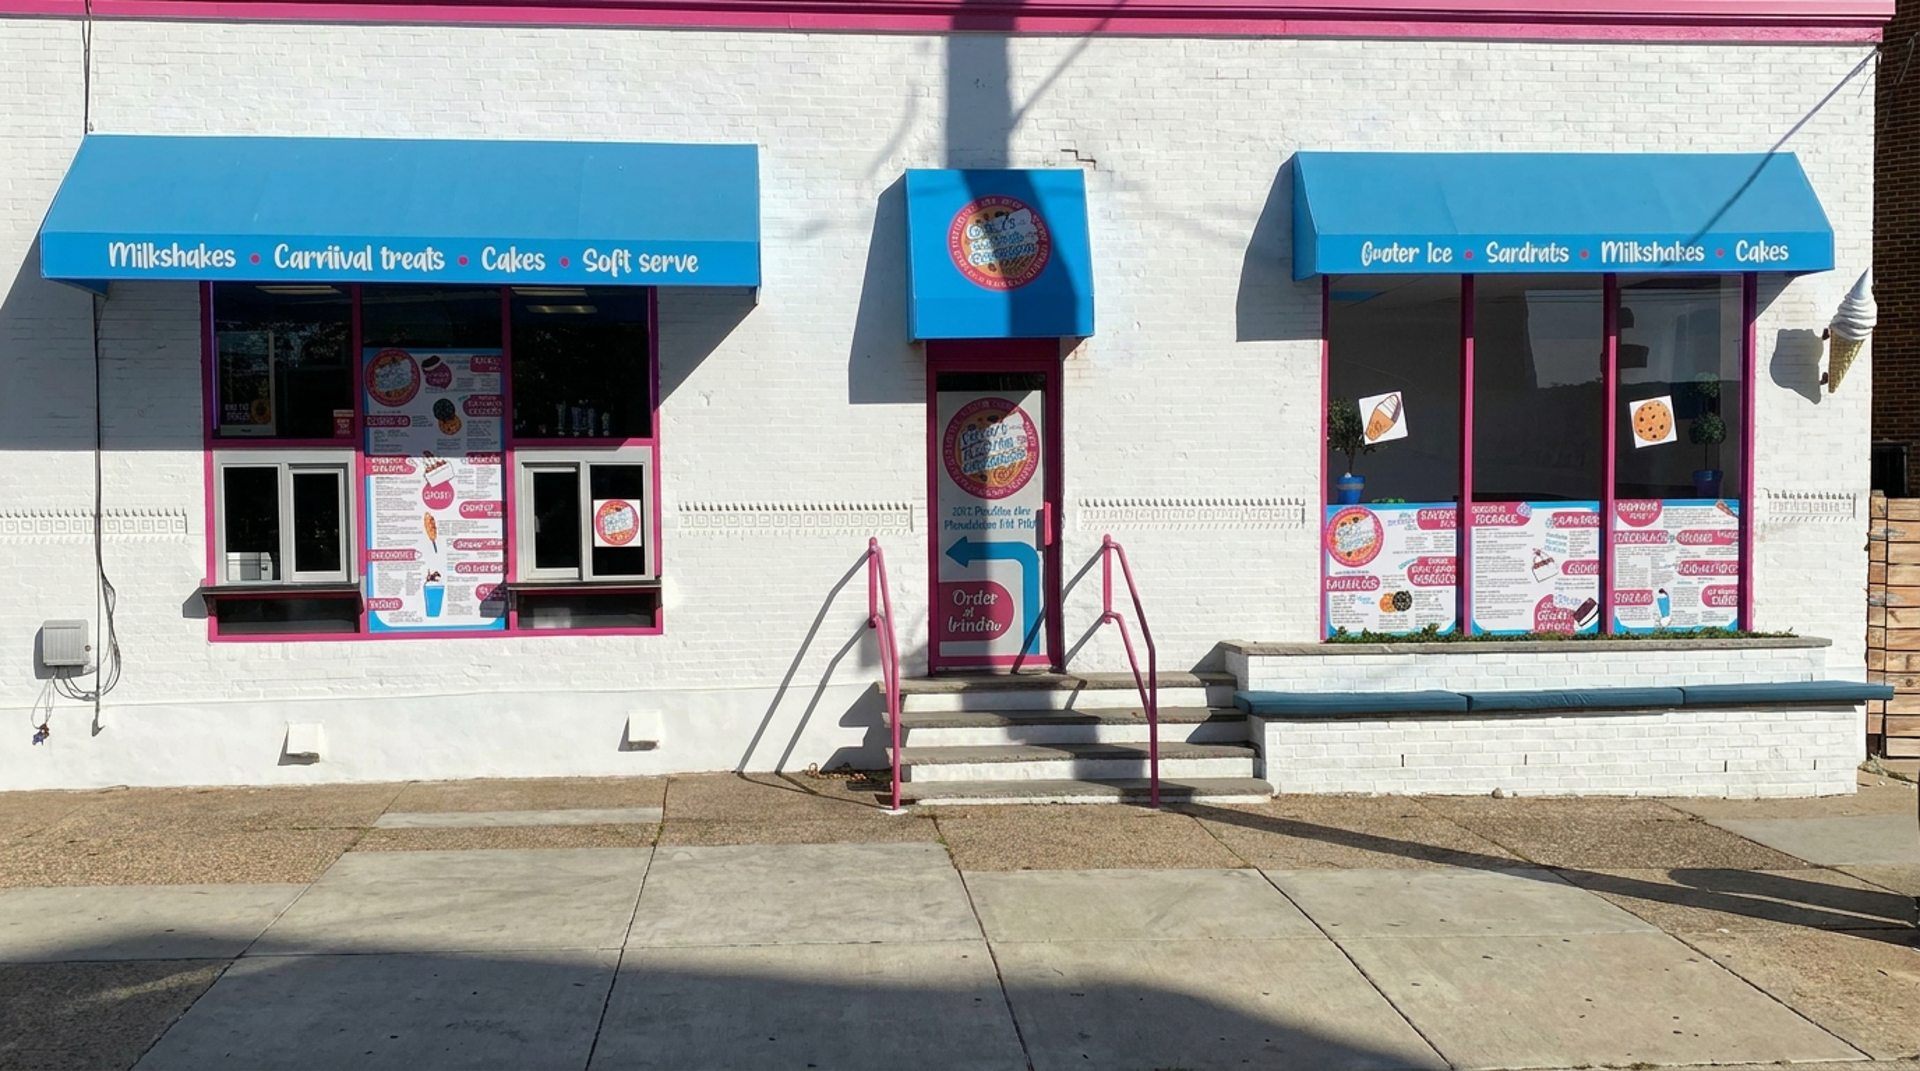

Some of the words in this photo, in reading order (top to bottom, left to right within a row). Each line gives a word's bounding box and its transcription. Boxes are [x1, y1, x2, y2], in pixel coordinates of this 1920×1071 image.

[108, 241, 236, 269] Milkshakes
[380, 245, 446, 273] treats
[481, 246, 546, 273] Cakes
[582, 247, 632, 278] Soft
[638, 253, 699, 273] serve
[1427, 241, 1453, 264] Ice
[1601, 240, 1705, 264] Milkshakes
[1735, 239, 1790, 264] Cakes
[952, 589, 999, 606] Order
